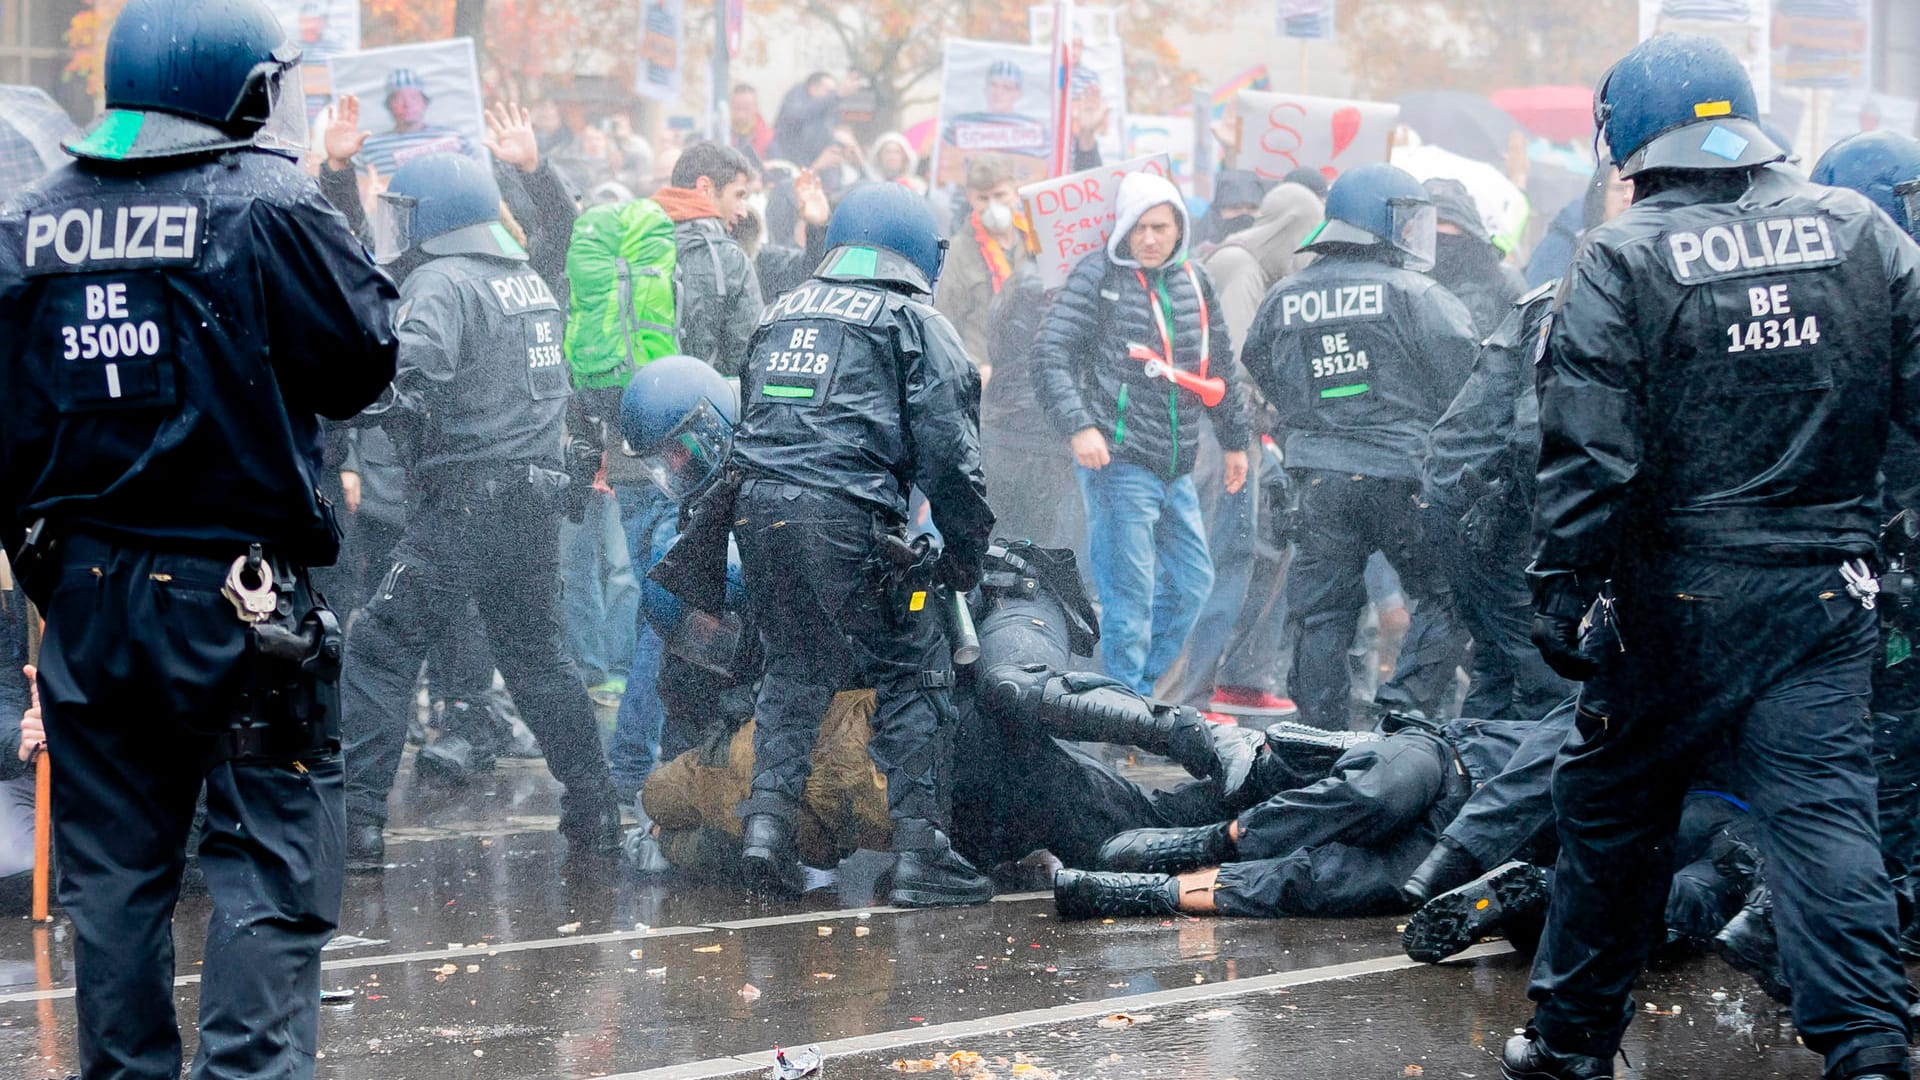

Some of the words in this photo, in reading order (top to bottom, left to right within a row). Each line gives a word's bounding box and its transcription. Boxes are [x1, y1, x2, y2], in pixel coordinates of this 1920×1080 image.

[1035, 177, 1105, 216] DDR
[26, 206, 198, 268] POLIZEI
[1669, 217, 1837, 278] POLIZEI
[86, 283, 129, 320] BE
[491, 274, 556, 310] POLIZ
[759, 286, 882, 325] POLIZEI
[1282, 284, 1383, 326] POLIZEI
[1748, 284, 1791, 317] BE
[62, 320, 160, 360] 35000
[535, 321, 553, 343] BE
[789, 328, 819, 350] BE
[1321, 332, 1350, 355] BE
[1727, 316, 1821, 353] 14314
[528, 345, 561, 369] 35336
[766, 351, 829, 375] 35128
[1311, 350, 1370, 378] 35124
